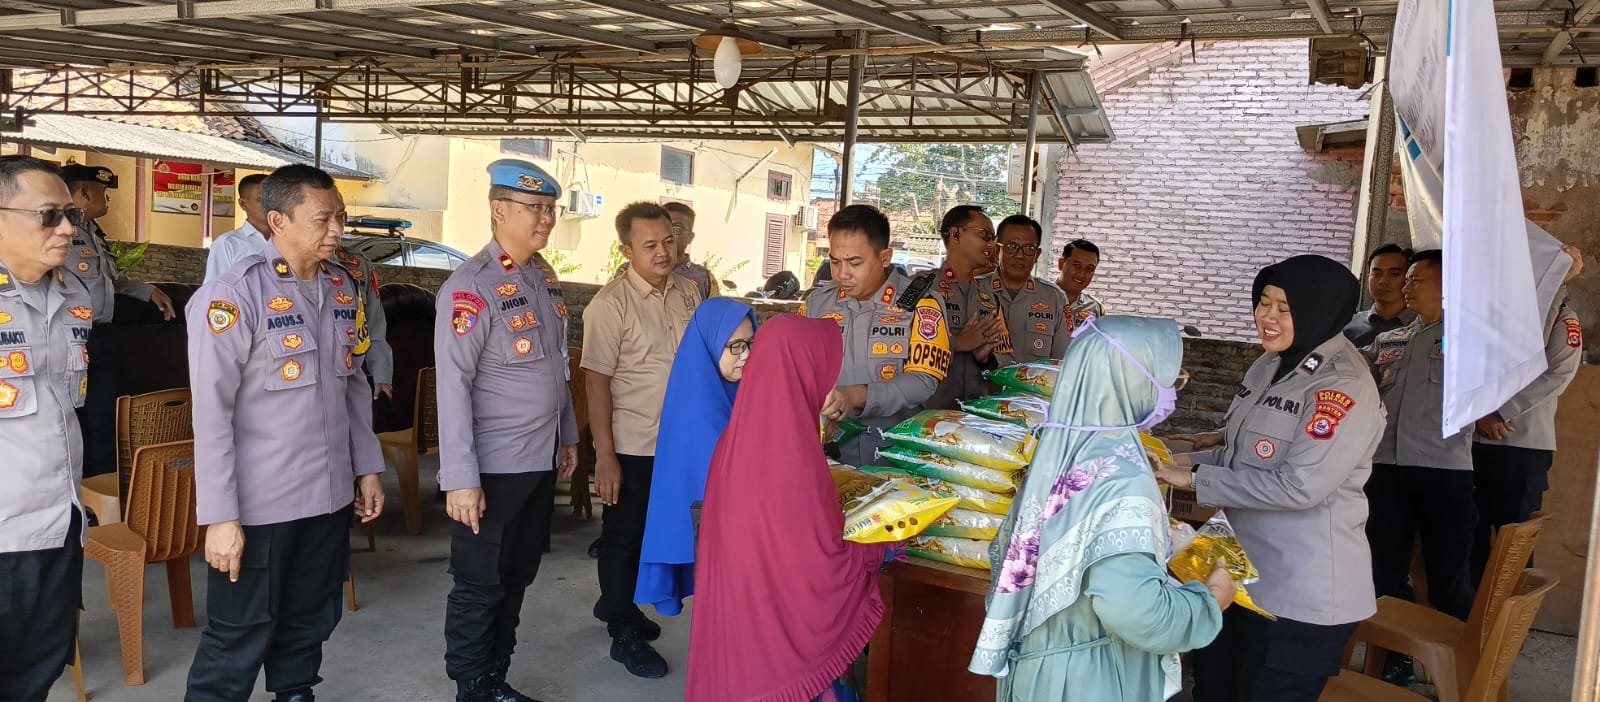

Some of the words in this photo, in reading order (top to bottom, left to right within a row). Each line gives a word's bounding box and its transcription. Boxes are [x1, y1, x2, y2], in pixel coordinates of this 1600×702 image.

[501, 296, 529, 311] JHONI
[267, 313, 305, 331] AGUS.S
[1028, 311, 1054, 321] POLRI
[871, 326, 905, 337] POLRI
